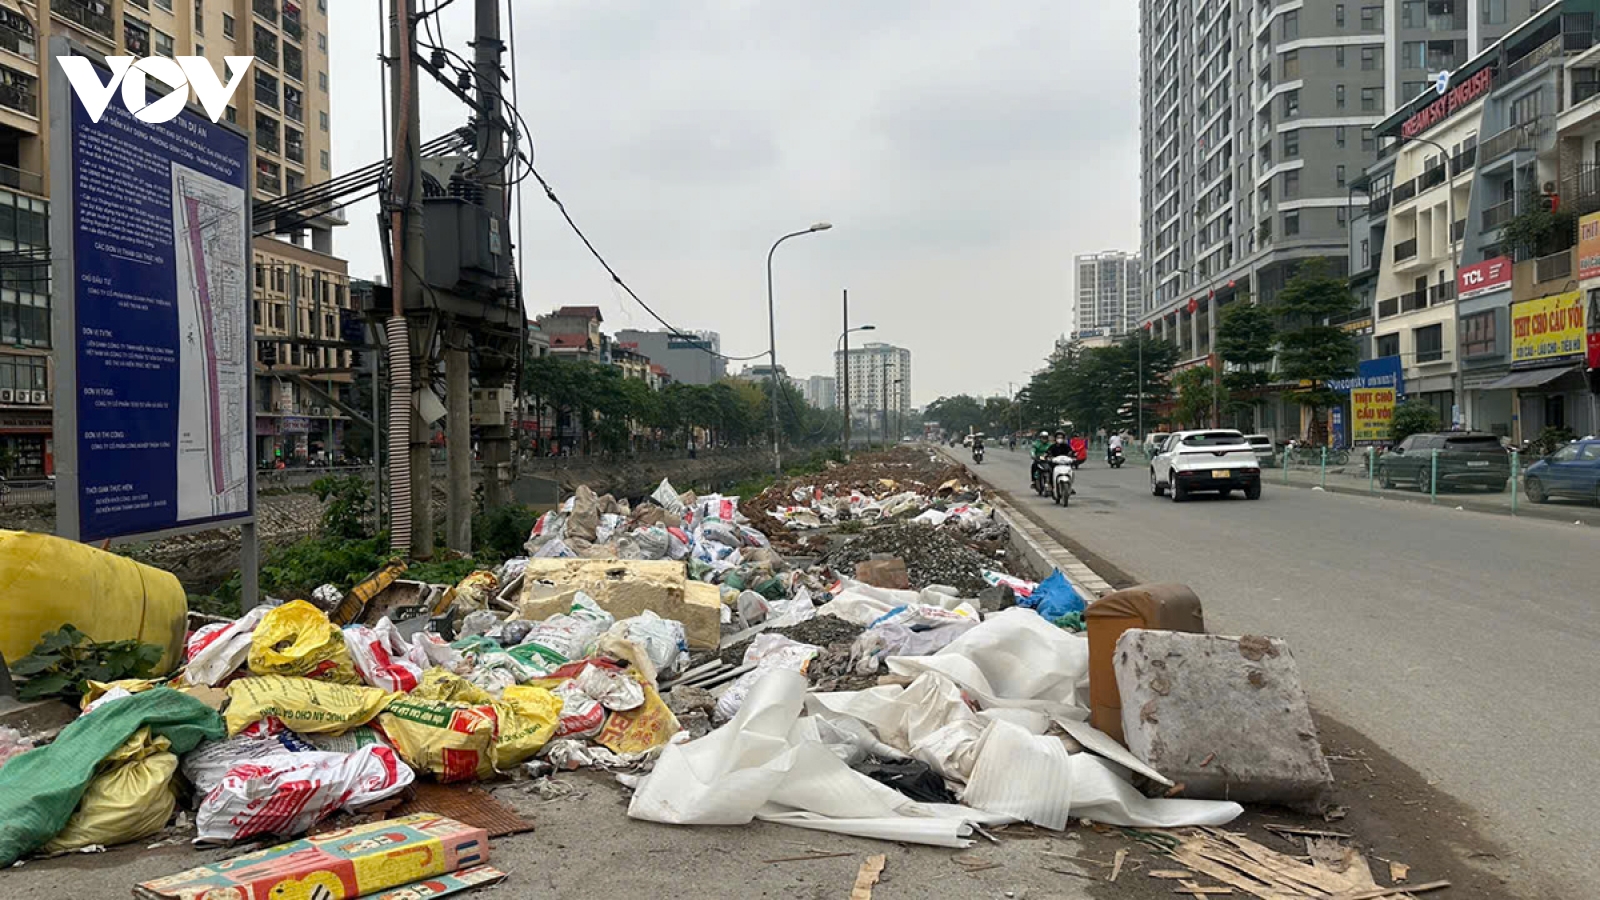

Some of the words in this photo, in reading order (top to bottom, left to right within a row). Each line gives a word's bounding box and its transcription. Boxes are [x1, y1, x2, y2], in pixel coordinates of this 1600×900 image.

[1448, 67, 1489, 110] ENGLISH
[1462, 268, 1484, 286] TCL
[1532, 306, 1548, 336] CHÓ
[1375, 390, 1392, 403] CHÓ
[295, 710, 312, 720] CHO
